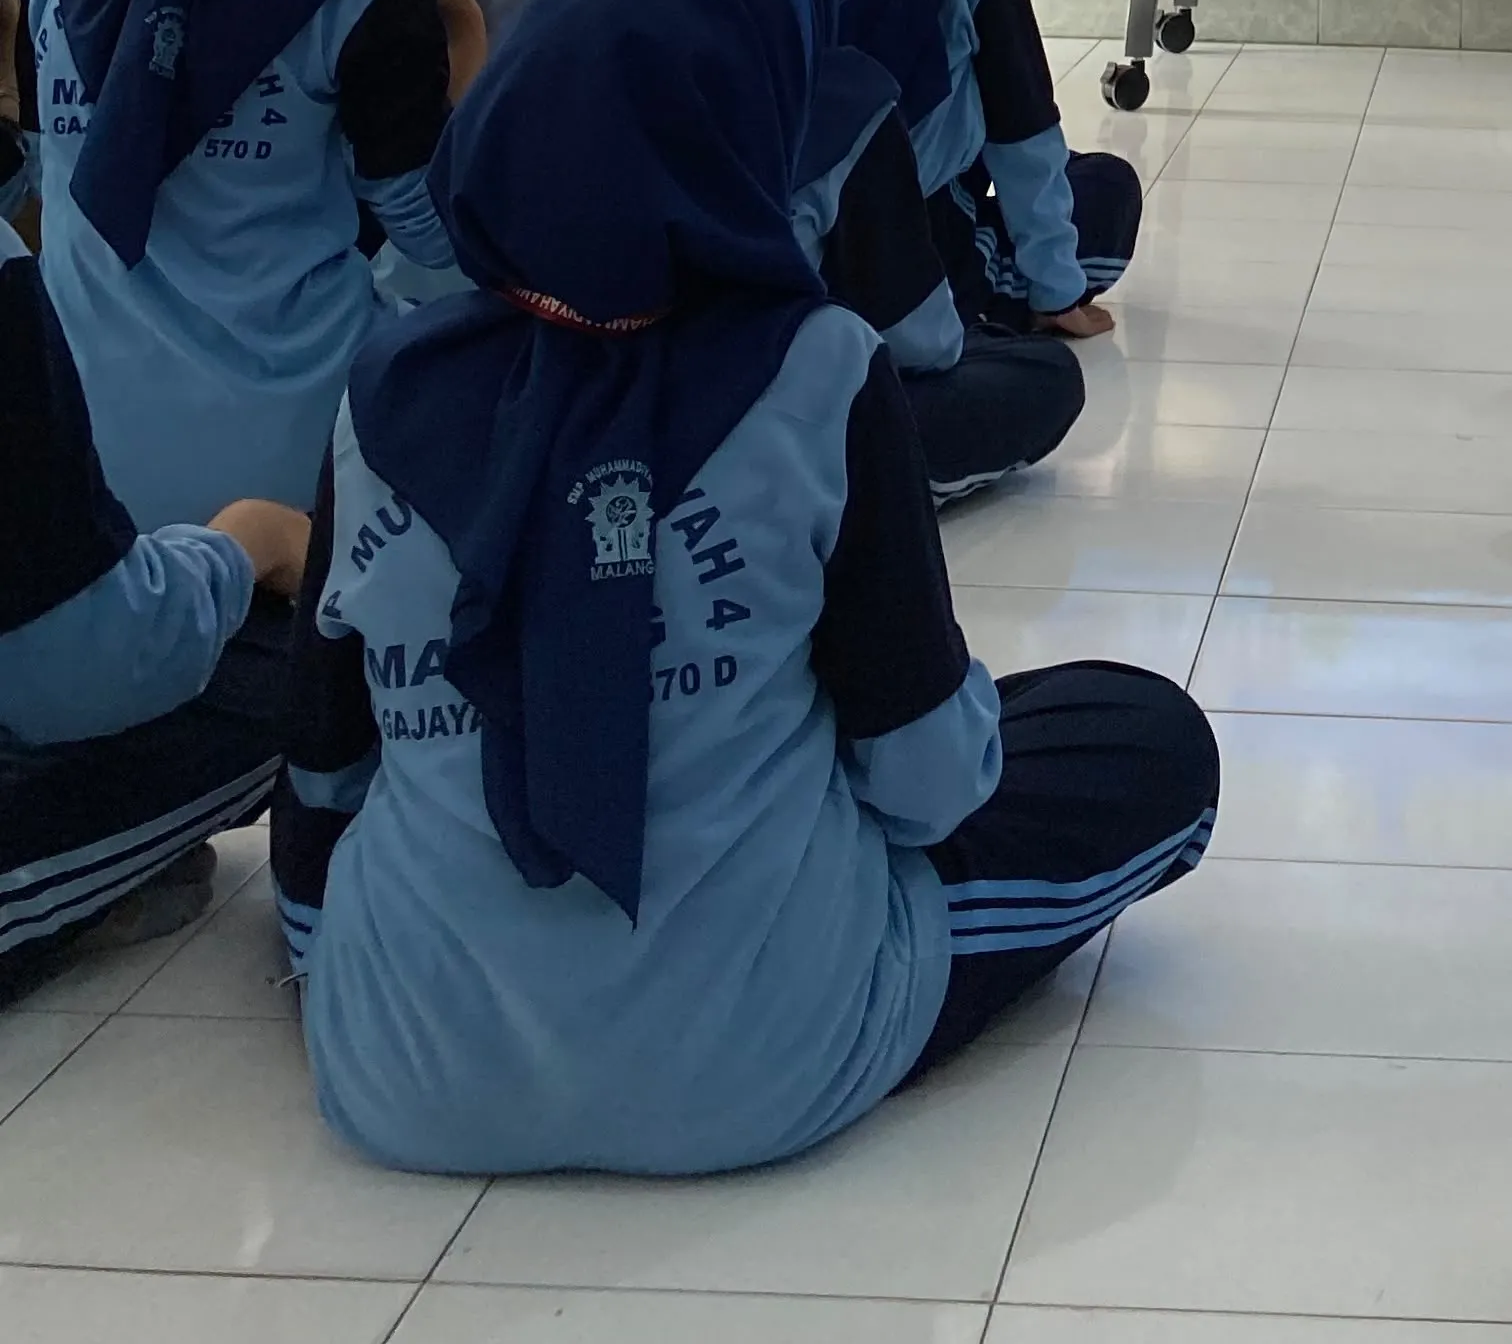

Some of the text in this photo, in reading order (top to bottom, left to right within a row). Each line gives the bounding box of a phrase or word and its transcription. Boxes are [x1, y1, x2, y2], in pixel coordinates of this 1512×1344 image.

[260, 108, 287, 125] 4
[204, 140, 272, 159] 570 D
[590, 560, 654, 581] MALANG
[705, 598, 751, 629] 4
[646, 654, 738, 701] 70 D
